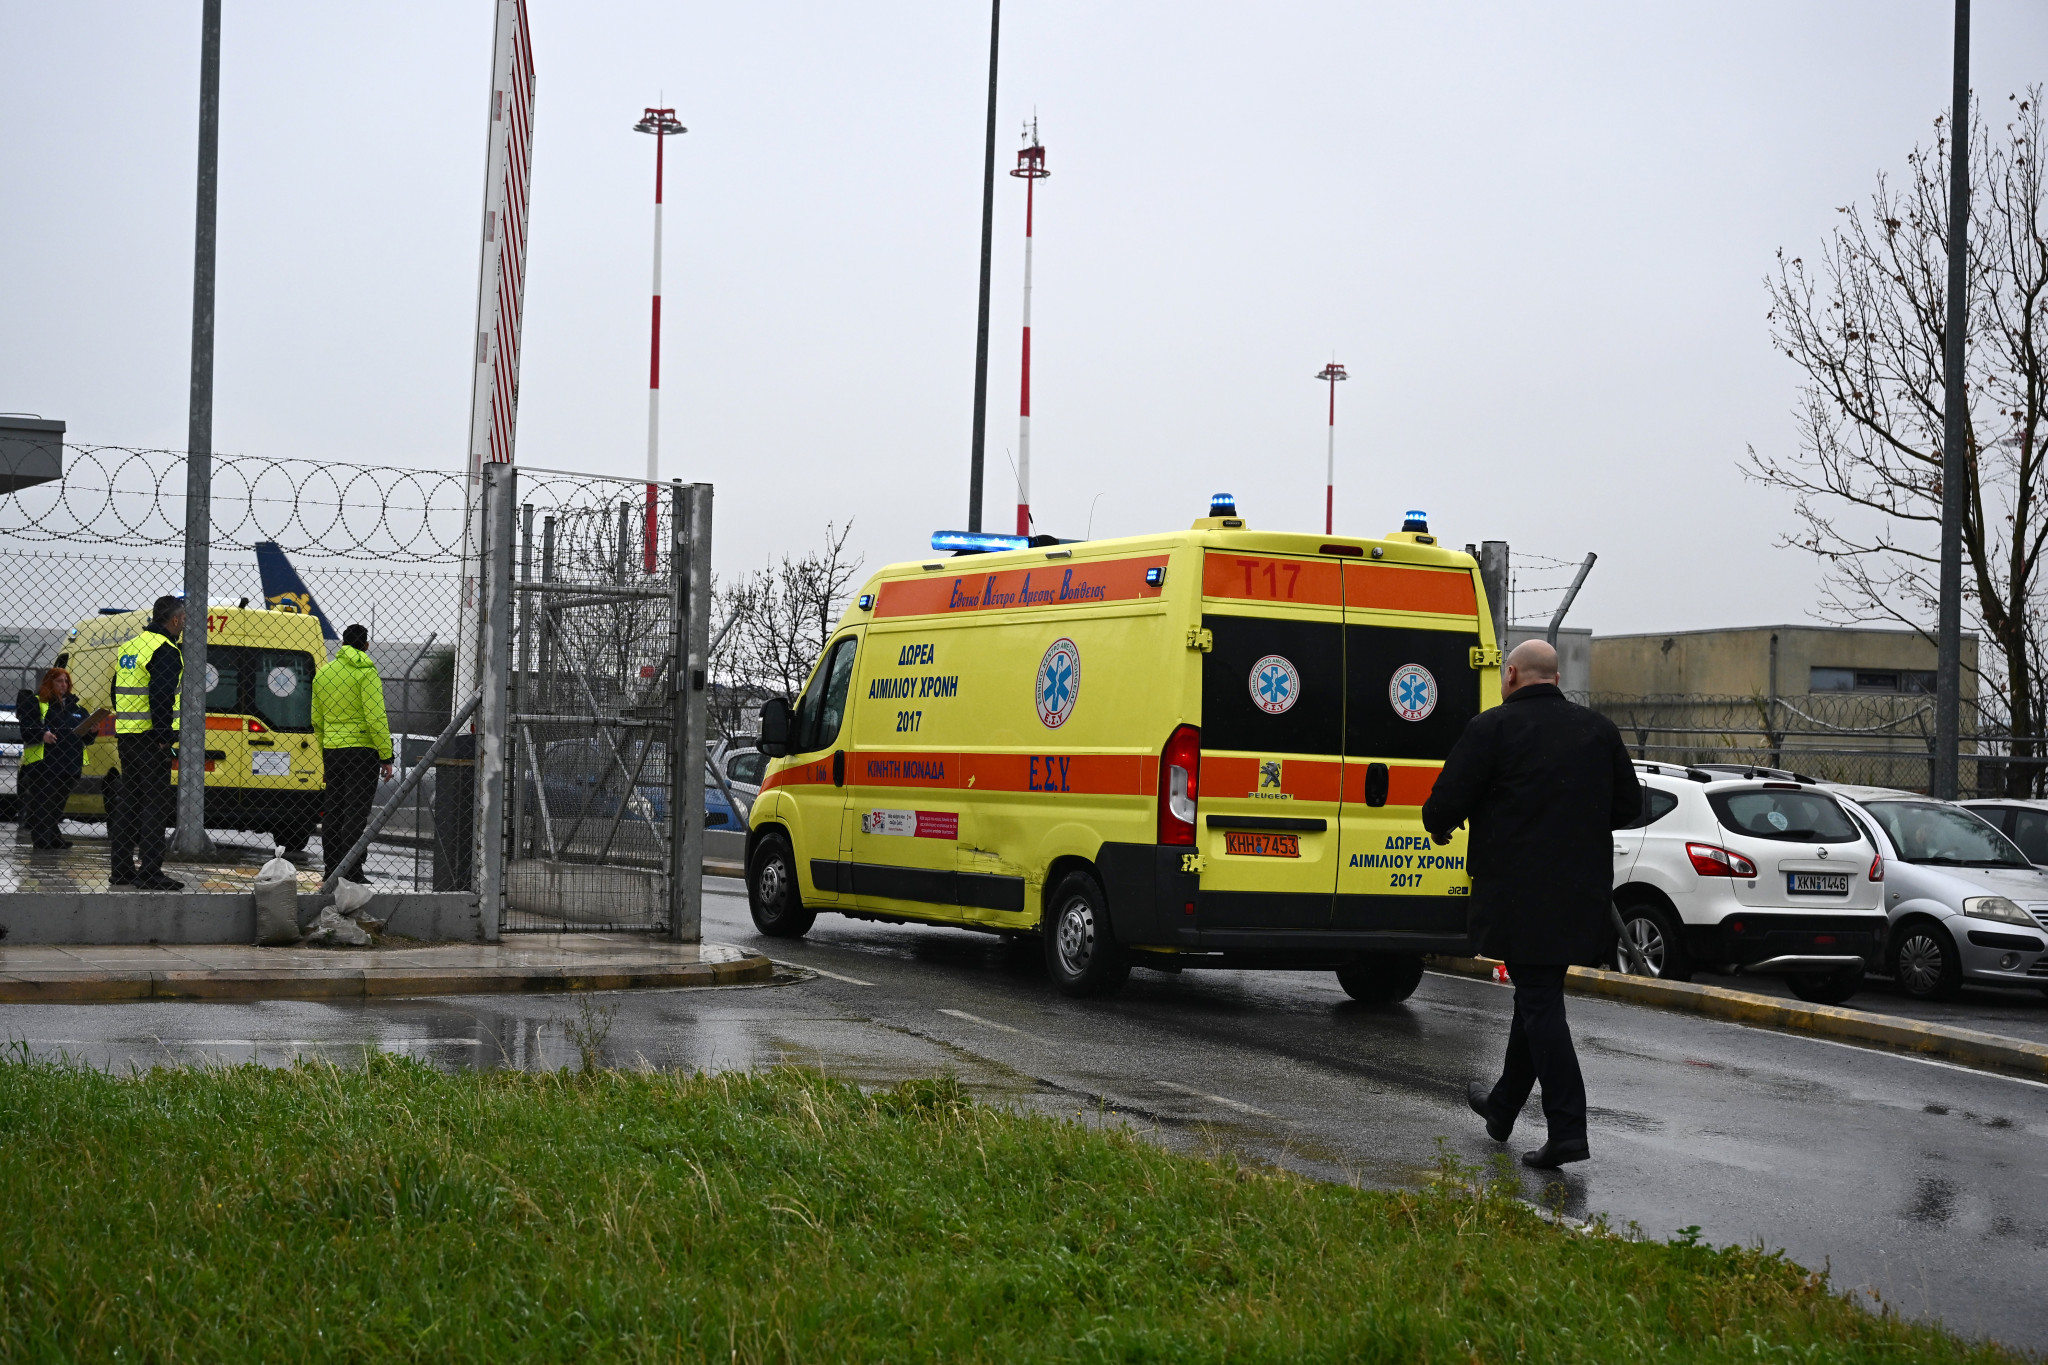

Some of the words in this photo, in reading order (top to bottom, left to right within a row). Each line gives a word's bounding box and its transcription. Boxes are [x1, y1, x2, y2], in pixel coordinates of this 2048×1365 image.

[983, 575, 1015, 608] Κέντρο
[1059, 568, 1107, 601] Βοήθειας
[1236, 559, 1301, 599] T17
[898, 643, 934, 666] ΔΩΡΕΑ
[868, 677, 918, 699] ΑΙΜΙΛΙΟΥ
[918, 675, 959, 698] ΧΡΟΝΗ
[896, 710, 922, 732] 2017
[867, 760, 901, 779] ΚΙΝΗΤΗ
[902, 760, 945, 779] ΜΟΝΑΔΑ
[1248, 792, 1292, 800] PEUGEOT
[1262, 836, 1297, 855] 7453
[1385, 836, 1431, 851] ΔΩΡΕΑ
[1348, 853, 1413, 869] ΑΙΜΙΛΙΟΥ
[1417, 855, 1465, 870] ΧΡΟΝΗ
[1389, 873, 1423, 888] 2017
[1797, 876, 1816, 890] XKN
[1821, 876, 1846, 891] 1446
